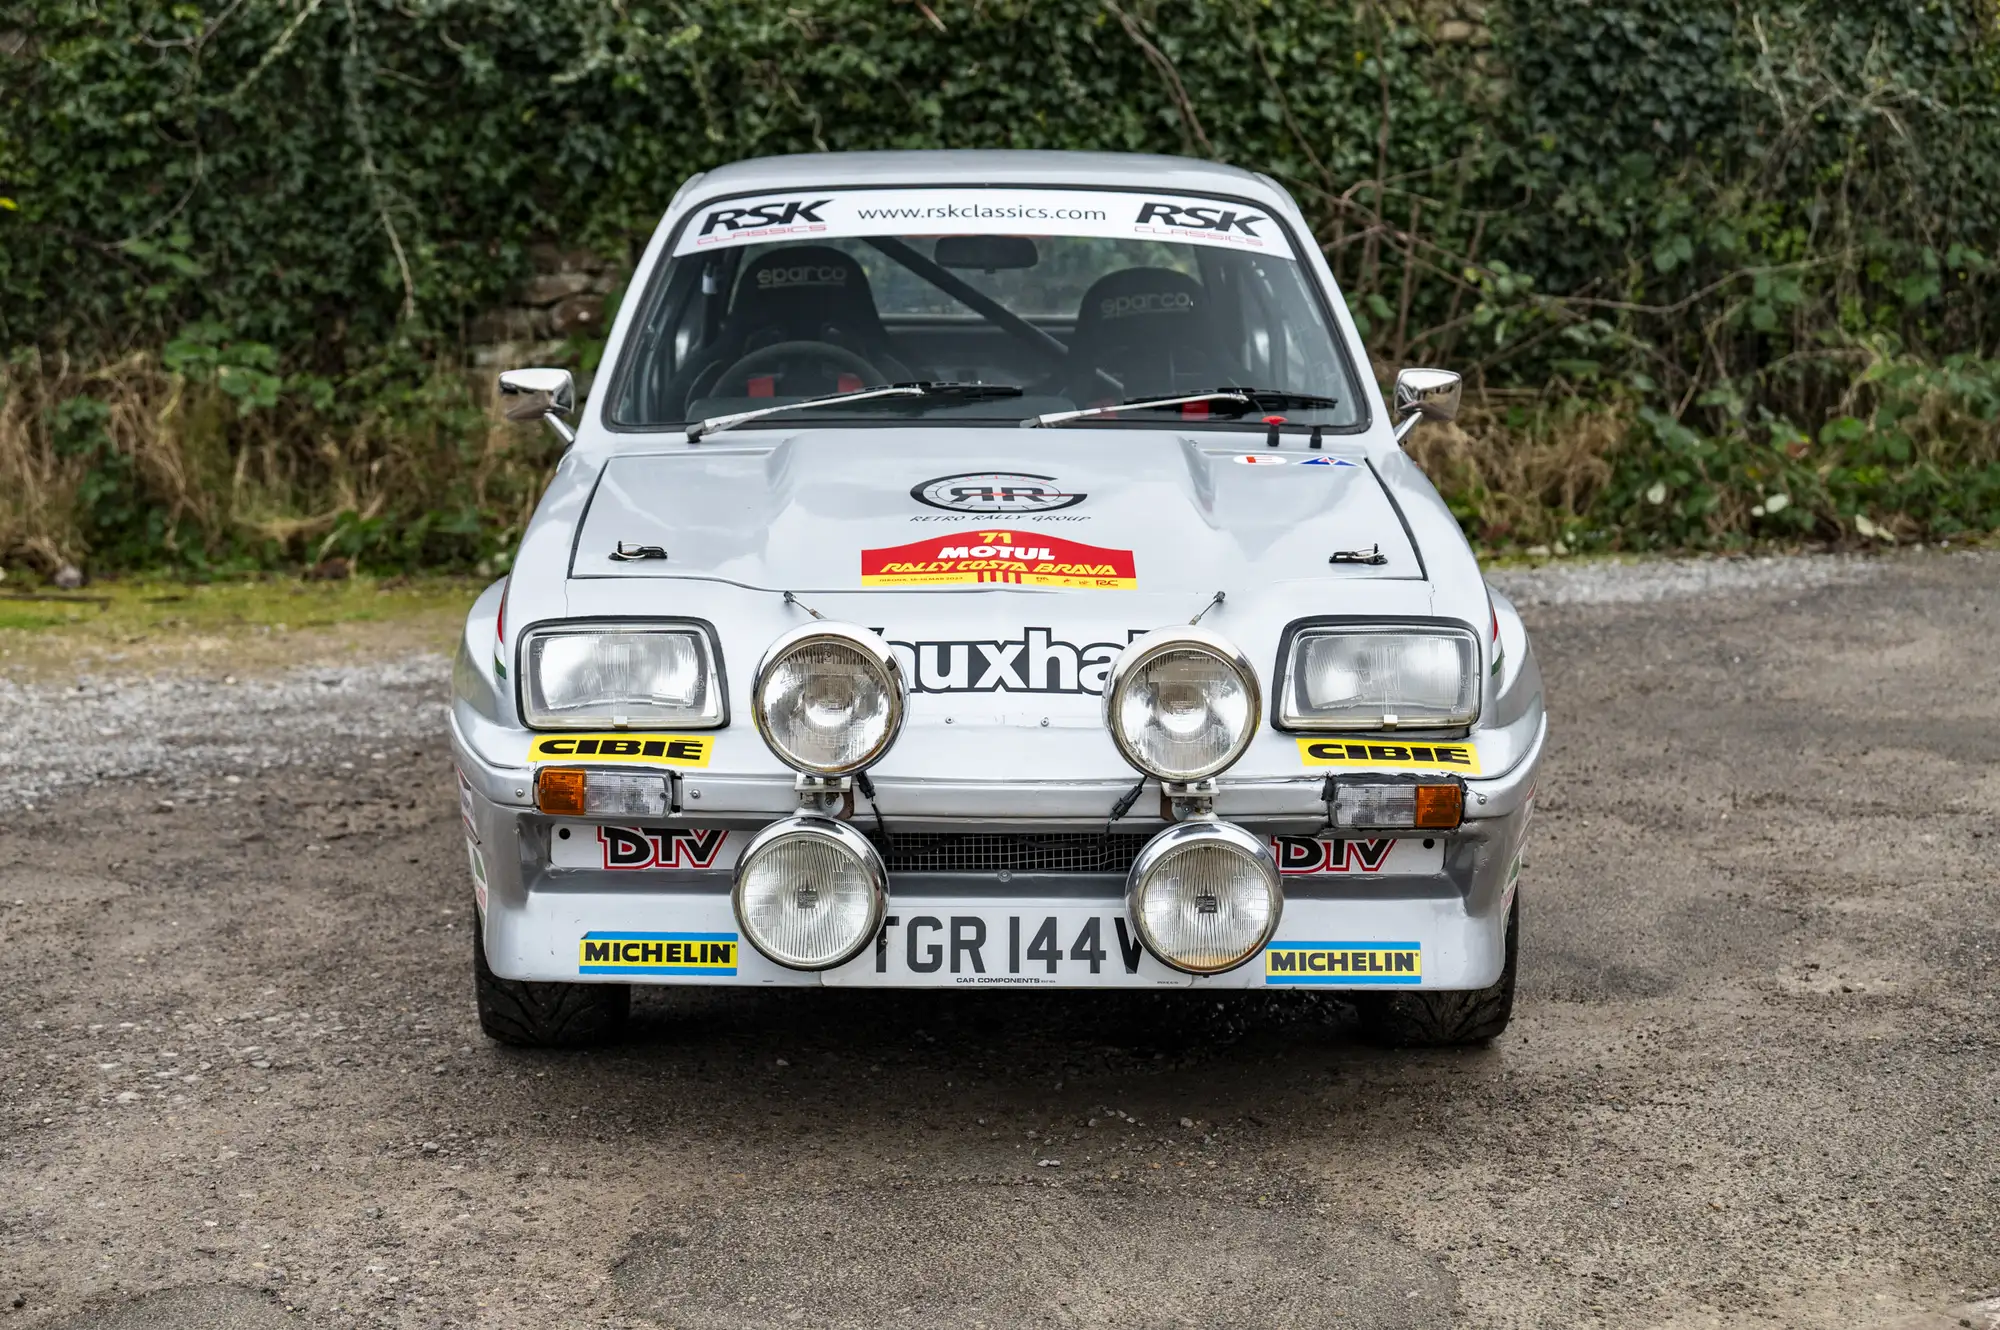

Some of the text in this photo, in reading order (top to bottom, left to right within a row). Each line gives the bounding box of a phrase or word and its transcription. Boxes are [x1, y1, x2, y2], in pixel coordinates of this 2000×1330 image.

[699, 199, 835, 236] RSK
[858, 204, 1106, 220] www.rskclassics.com
[1135, 202, 1267, 237] RSK
[697, 225, 826, 245] CLASSICS
[1134, 226, 1263, 246] CLASSICS
[757, 265, 847, 288] sparco
[1101, 292, 1189, 317] sparco
[979, 532, 1012, 544] 71
[937, 546, 1056, 560] MOTUL
[880, 560, 1118, 576] RALLY COSTA BRAVA
[597, 826, 730, 870] DTV
[585, 942, 731, 964] MICHELIN
[876, 916, 1142, 974] TGR 144V
[1271, 952, 1415, 972] MICHELIN
